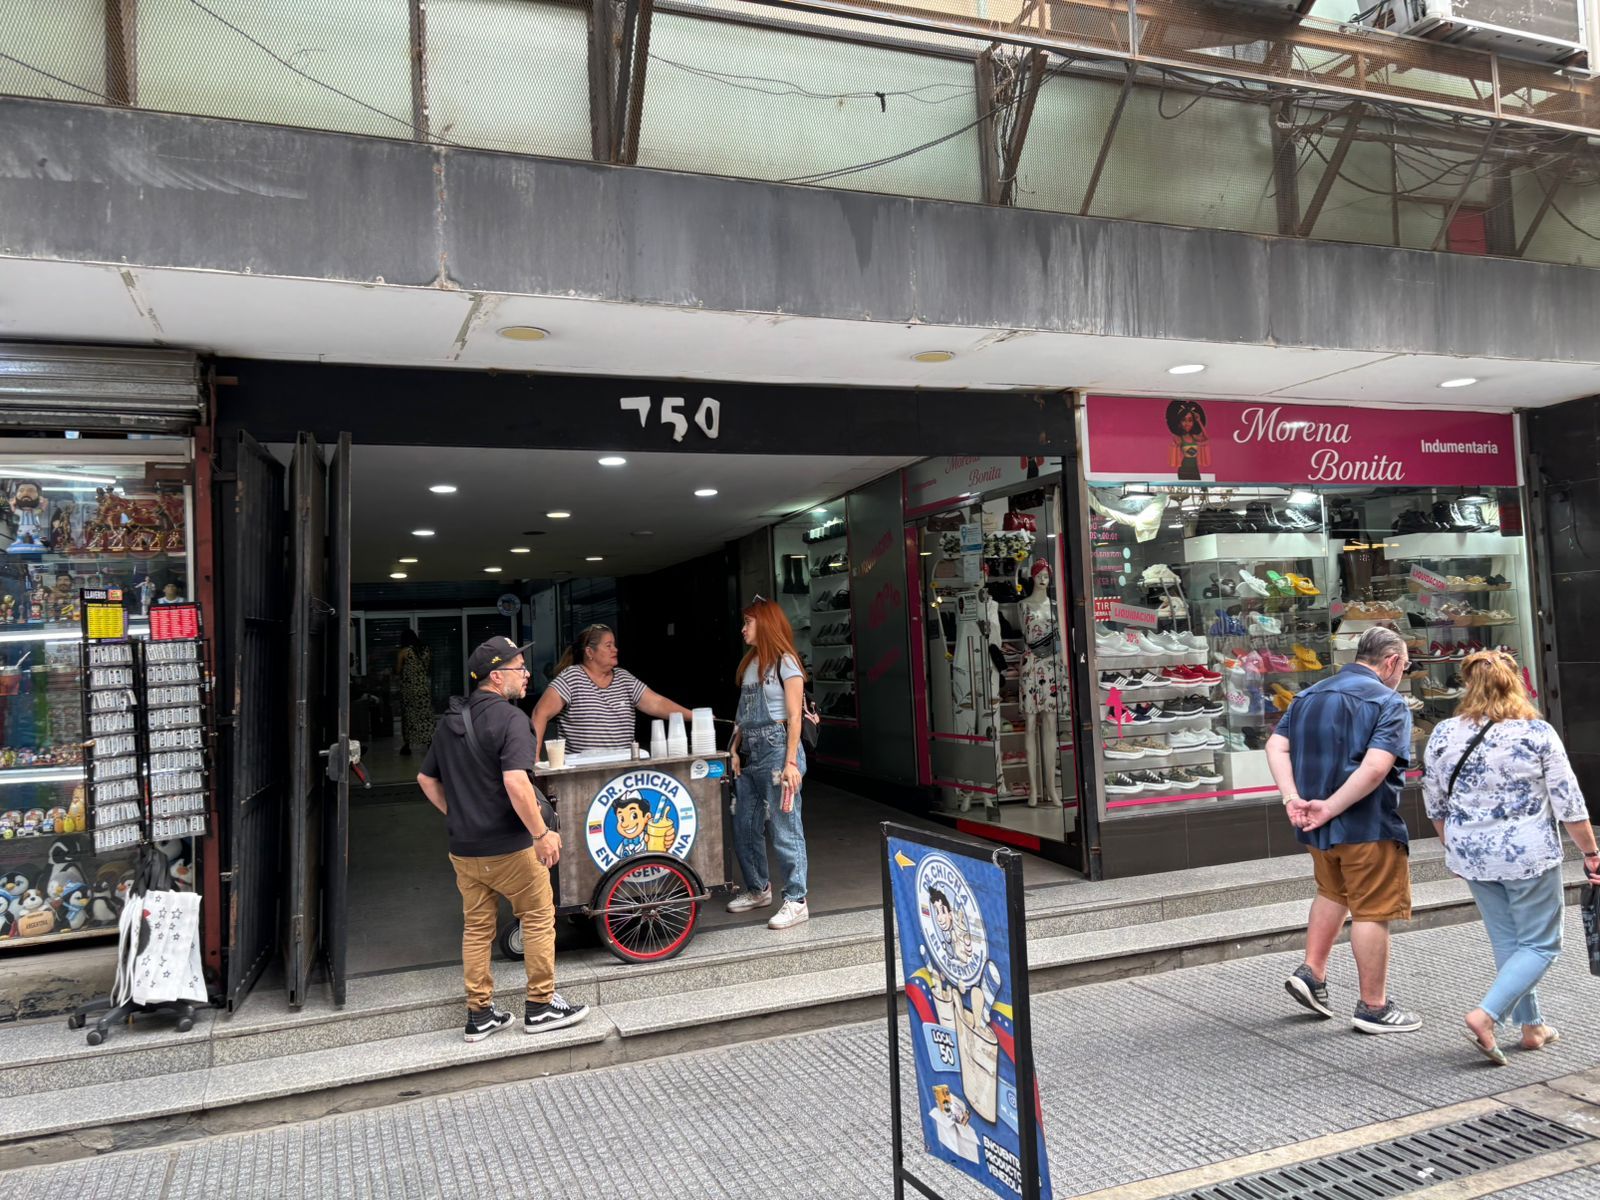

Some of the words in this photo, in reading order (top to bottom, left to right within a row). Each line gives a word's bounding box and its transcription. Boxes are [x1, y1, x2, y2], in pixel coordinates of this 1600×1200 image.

[620, 396, 720, 442] 750
[1233, 407, 1351, 444] Morena
[1421, 439, 1498, 454] Indumentaria
[968, 466, 1002, 487] Bonita
[1308, 448, 1405, 481] Bonita
[1114, 607, 1156, 624] LIQUIDACION
[597, 786, 622, 807] DR.
[623, 773, 680, 798] CHICHA
[595, 847, 614, 867] EN
[923, 874, 933, 892] DR.
[931, 864, 968, 907] CHICHA
[930, 932, 941, 953] EN
[941, 952, 980, 977] ARGENTINA
[931, 1028, 955, 1048] LOCAL
[939, 1044, 955, 1066] 50
[982, 1135, 1021, 1170] ENCUENTR
[984, 1149, 1022, 1184] PRODUCTO
[986, 1161, 1022, 1197] VENEZOLA
